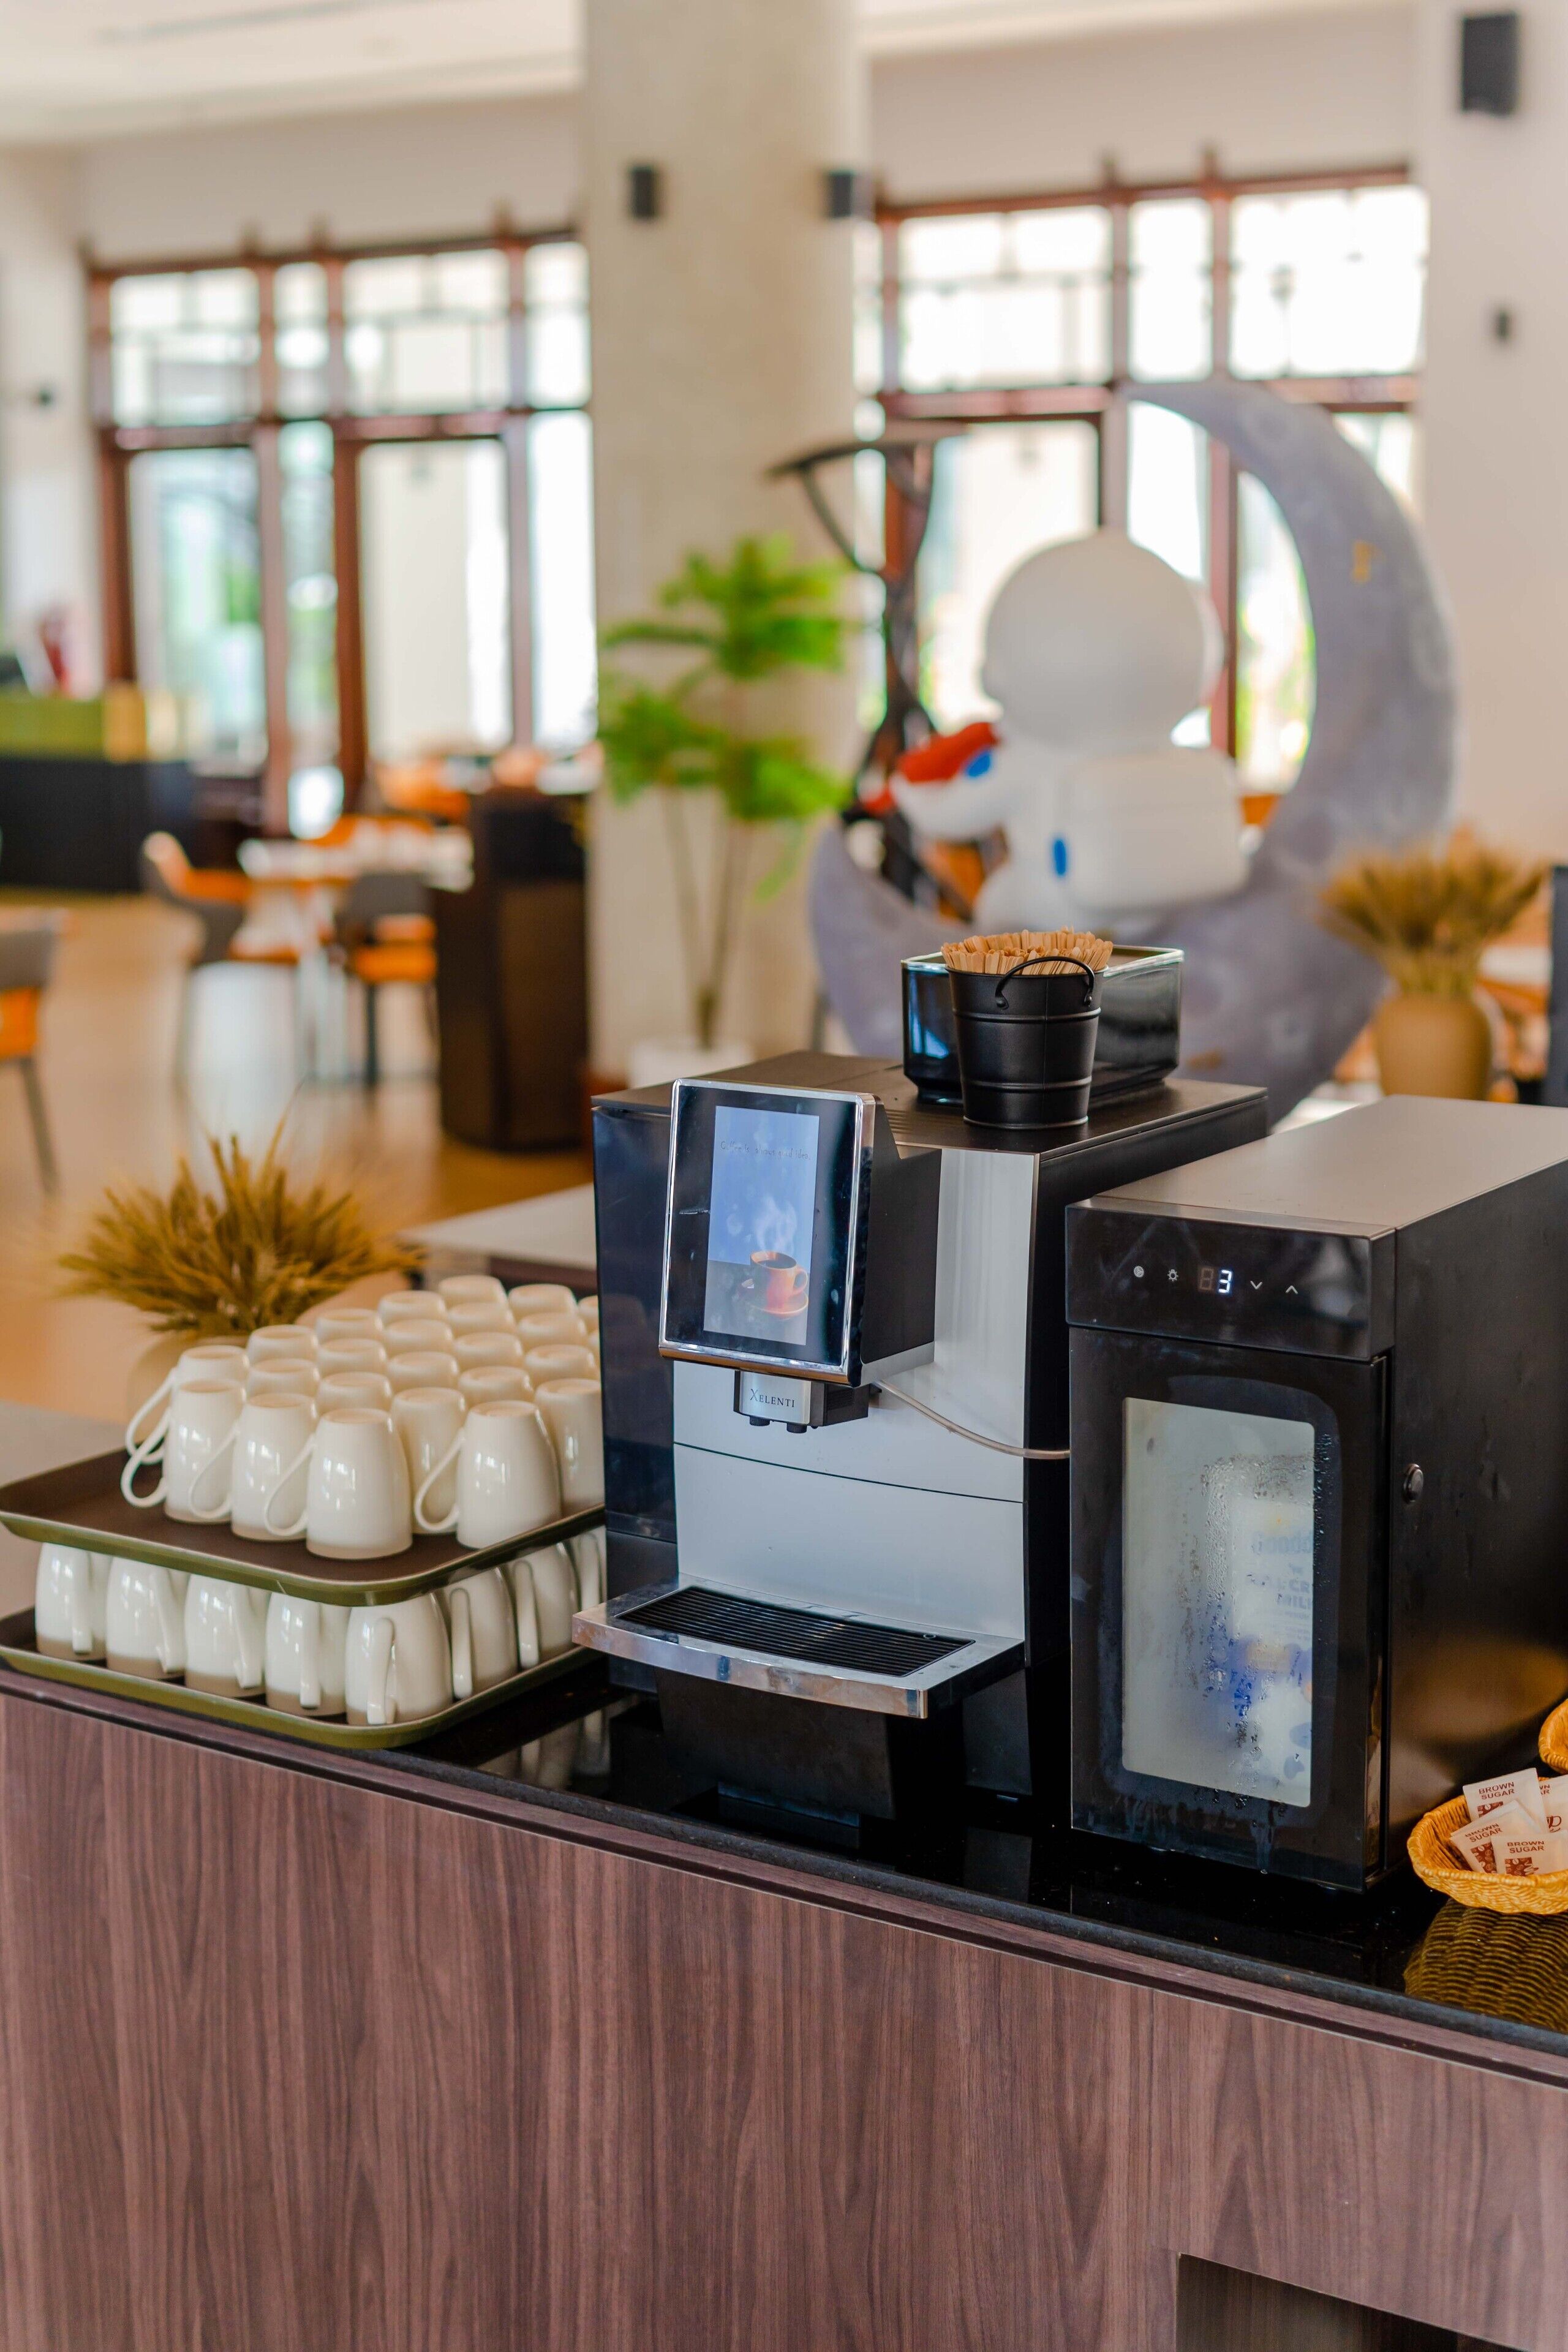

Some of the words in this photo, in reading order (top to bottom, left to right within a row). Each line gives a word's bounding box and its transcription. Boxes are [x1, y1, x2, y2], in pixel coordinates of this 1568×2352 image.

[750, 1389, 796, 1408] XELENTI
[1479, 1781, 1515, 1795] BROWN
[1481, 1789, 1515, 1800] SUGAR
[1469, 1828, 1503, 1842] SUGAR
[1509, 1844, 1545, 1853] SUGAR
